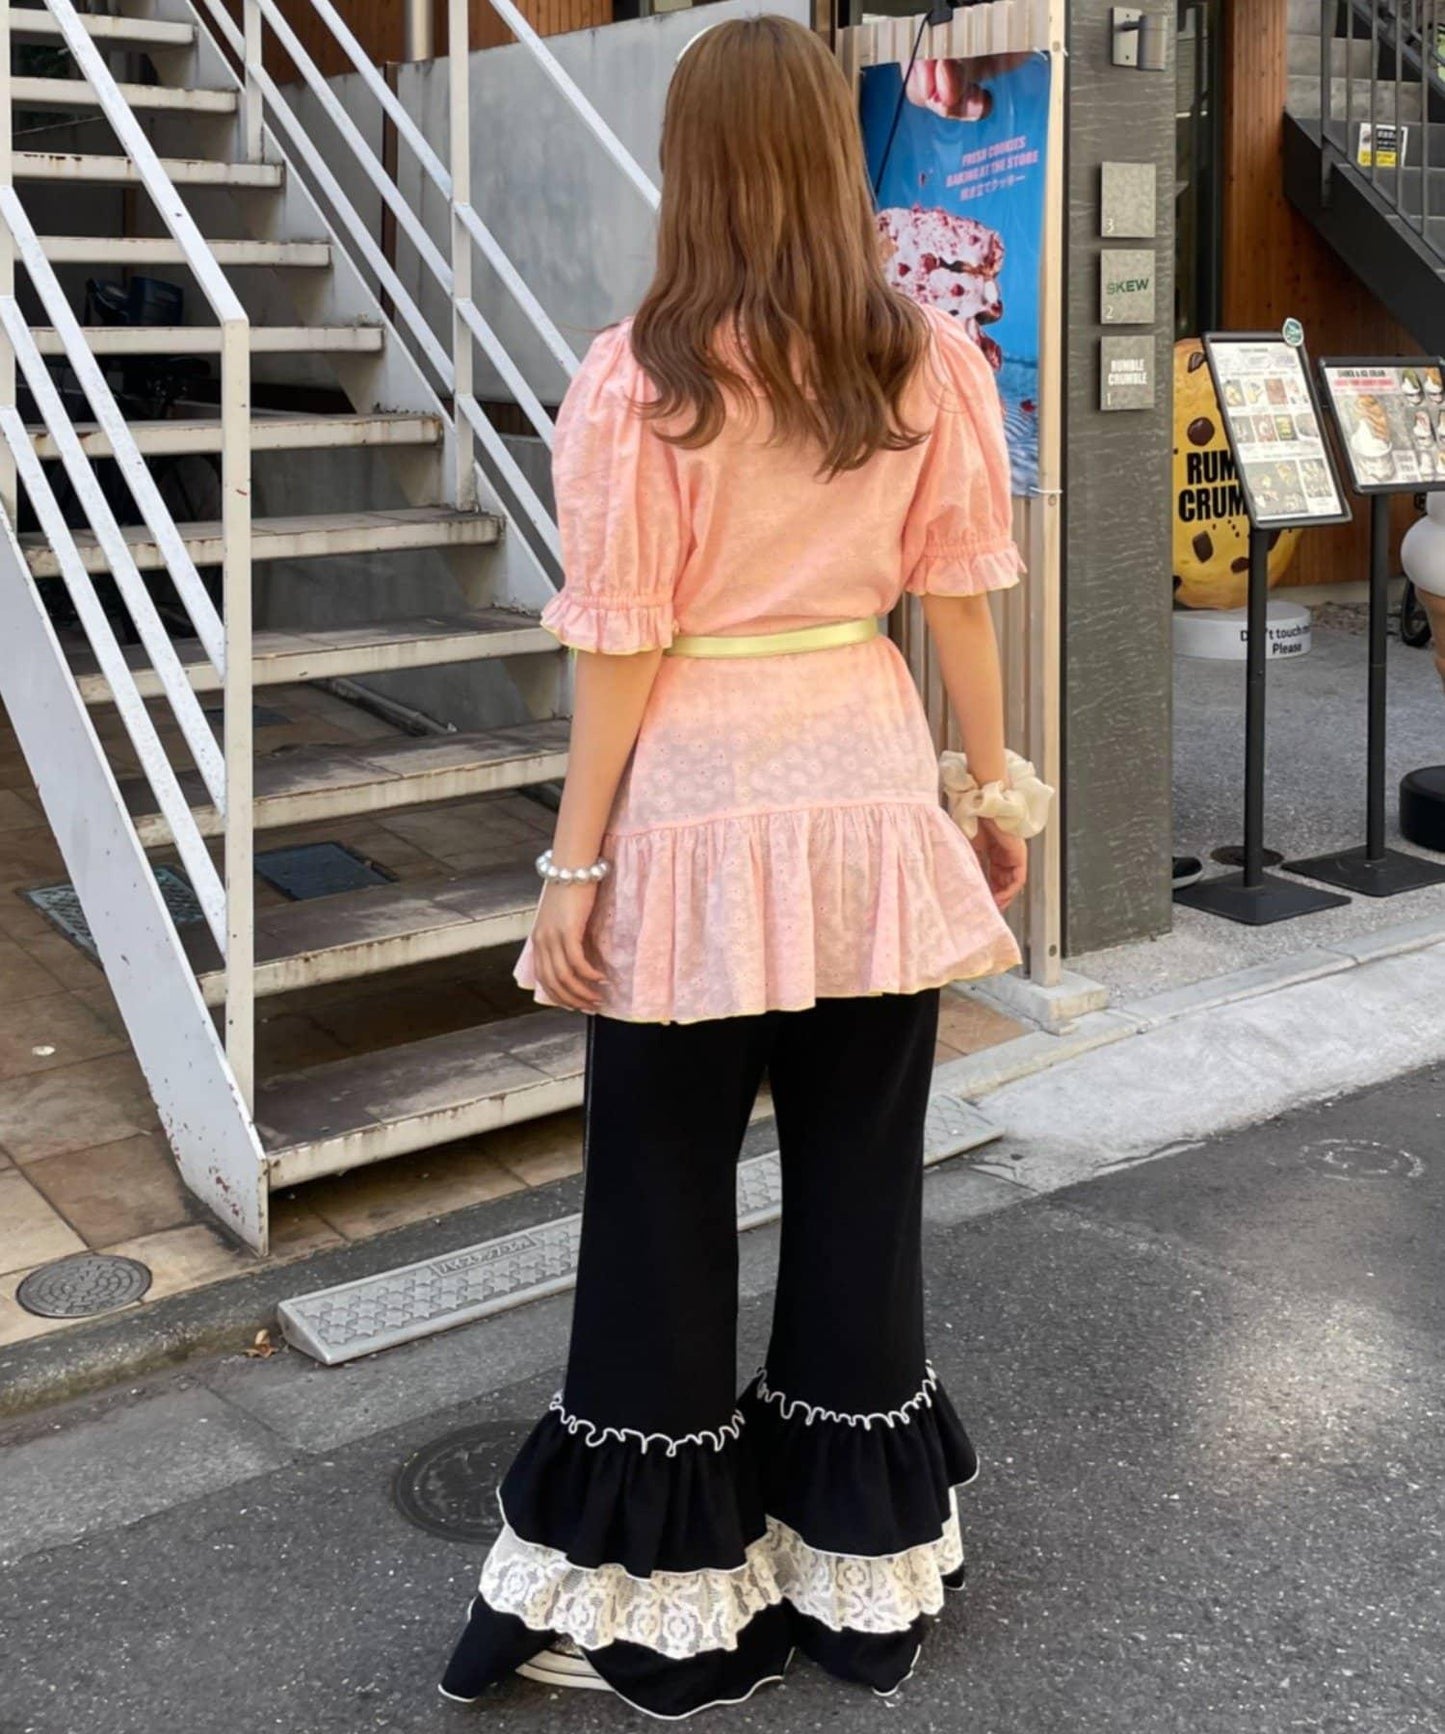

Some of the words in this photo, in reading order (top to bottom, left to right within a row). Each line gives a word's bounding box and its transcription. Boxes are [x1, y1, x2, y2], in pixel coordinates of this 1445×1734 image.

[1106, 218, 1114, 233] 3
[1106, 278, 1149, 295] SKEW
[1105, 304, 1113, 319] 2
[1106, 392, 1112, 406] 1
[1187, 450, 1238, 485] RUM
[1178, 485, 1247, 522] CRUM
[1276, 624, 1302, 639] touch
[1272, 642, 1302, 654] Please
